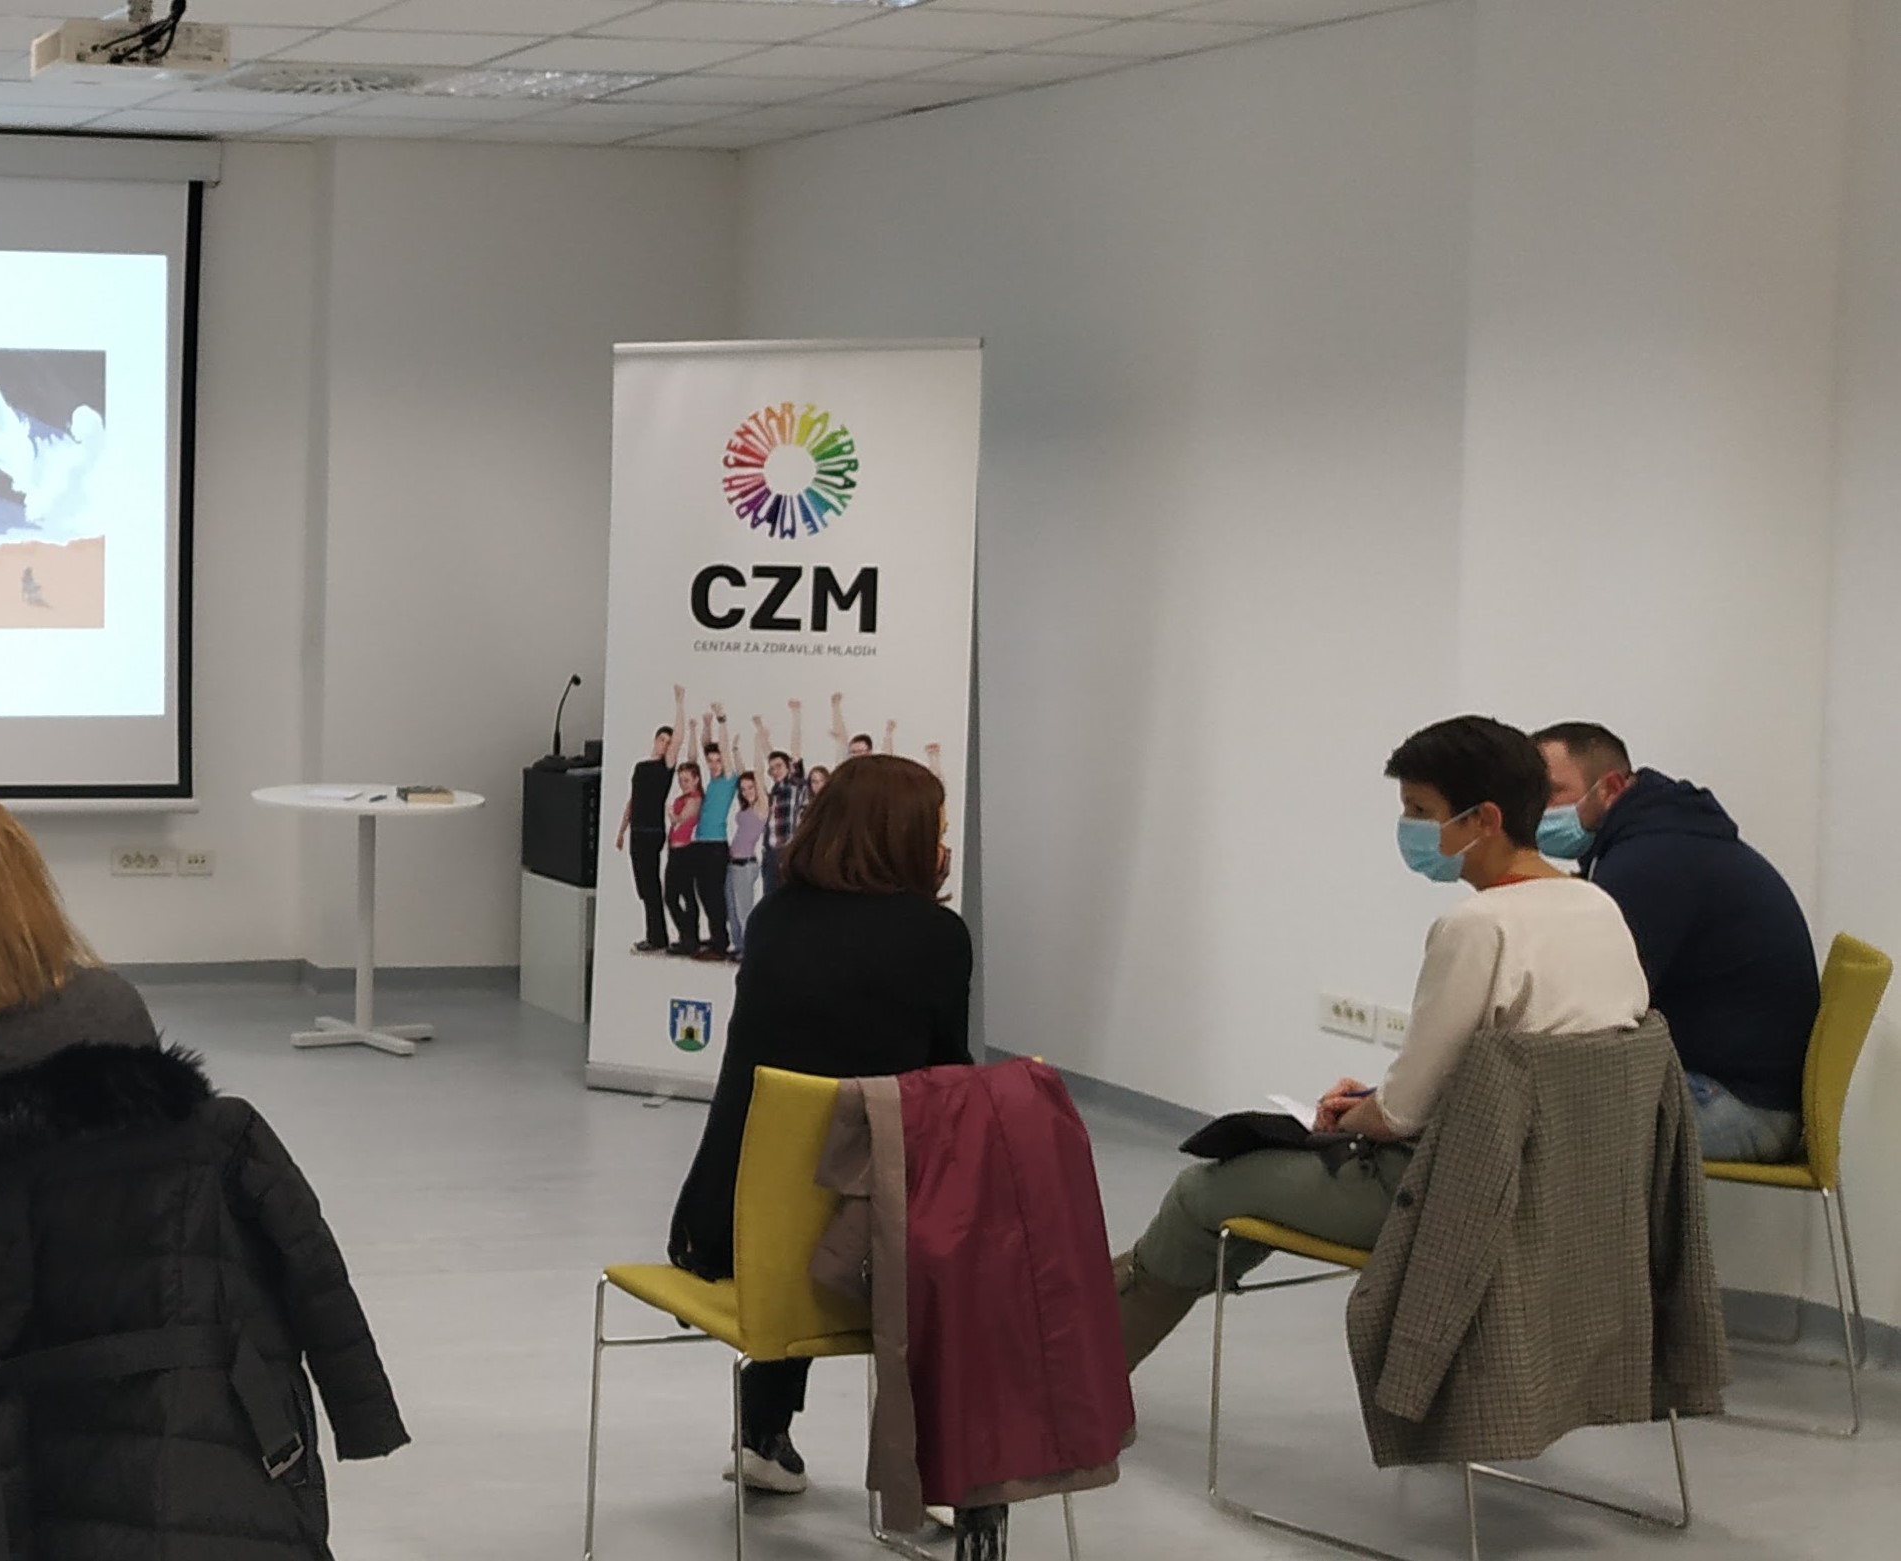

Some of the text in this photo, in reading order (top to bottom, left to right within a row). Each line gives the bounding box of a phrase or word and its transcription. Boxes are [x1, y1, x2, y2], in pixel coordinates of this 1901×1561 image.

[690, 564, 879, 634] CZM
[693, 640, 742, 654] CENTAR
[743, 641, 760, 654] ZA
